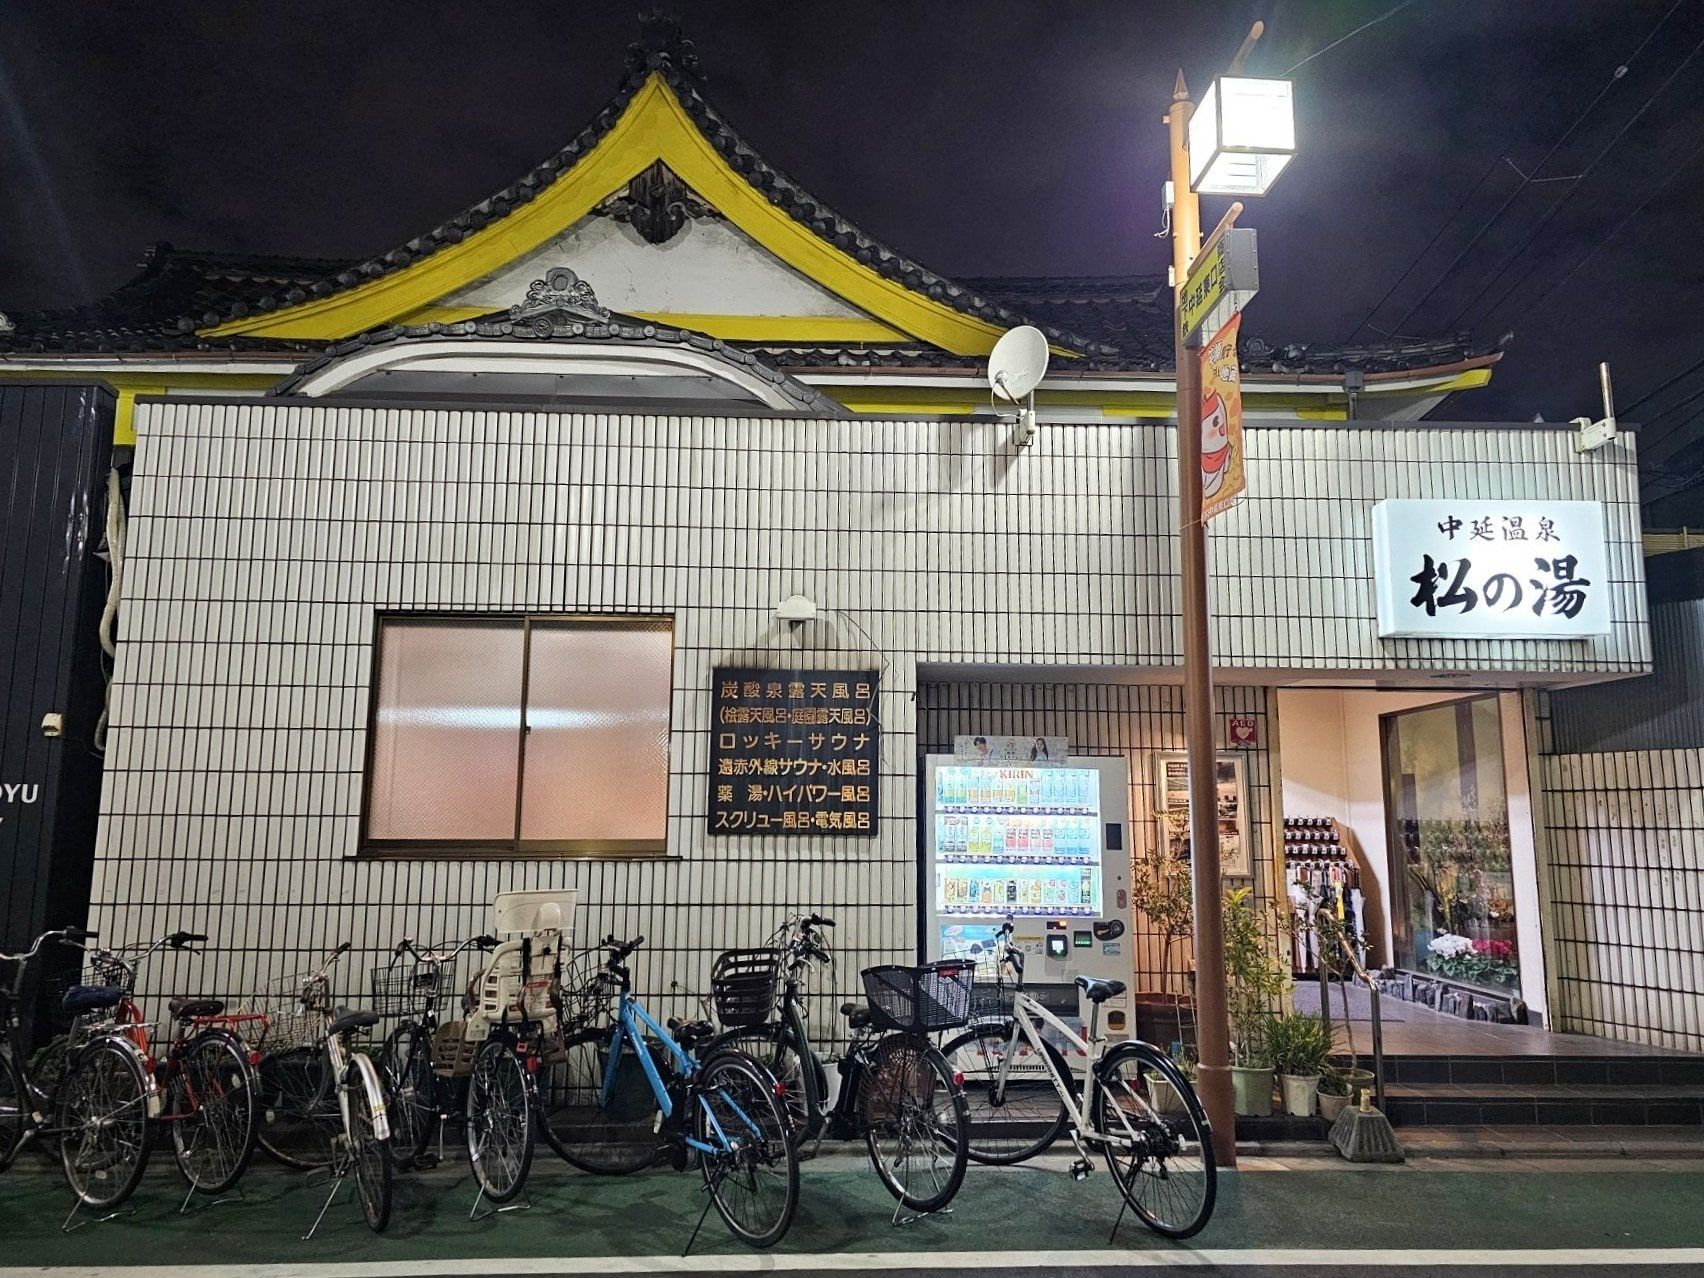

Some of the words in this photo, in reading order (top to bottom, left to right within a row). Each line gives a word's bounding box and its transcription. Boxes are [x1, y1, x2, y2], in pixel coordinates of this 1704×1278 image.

[1437, 515, 1561, 542] 中延温泉
[1409, 553, 1591, 619] 松の湯
[720, 681, 871, 700] 炭酸泉露天風呂
[719, 732, 870, 751] ロッキーサウナ
[1000, 769, 1034, 779] KIRIN
[715, 811, 870, 830] スクリュー風呂・電気風呂
